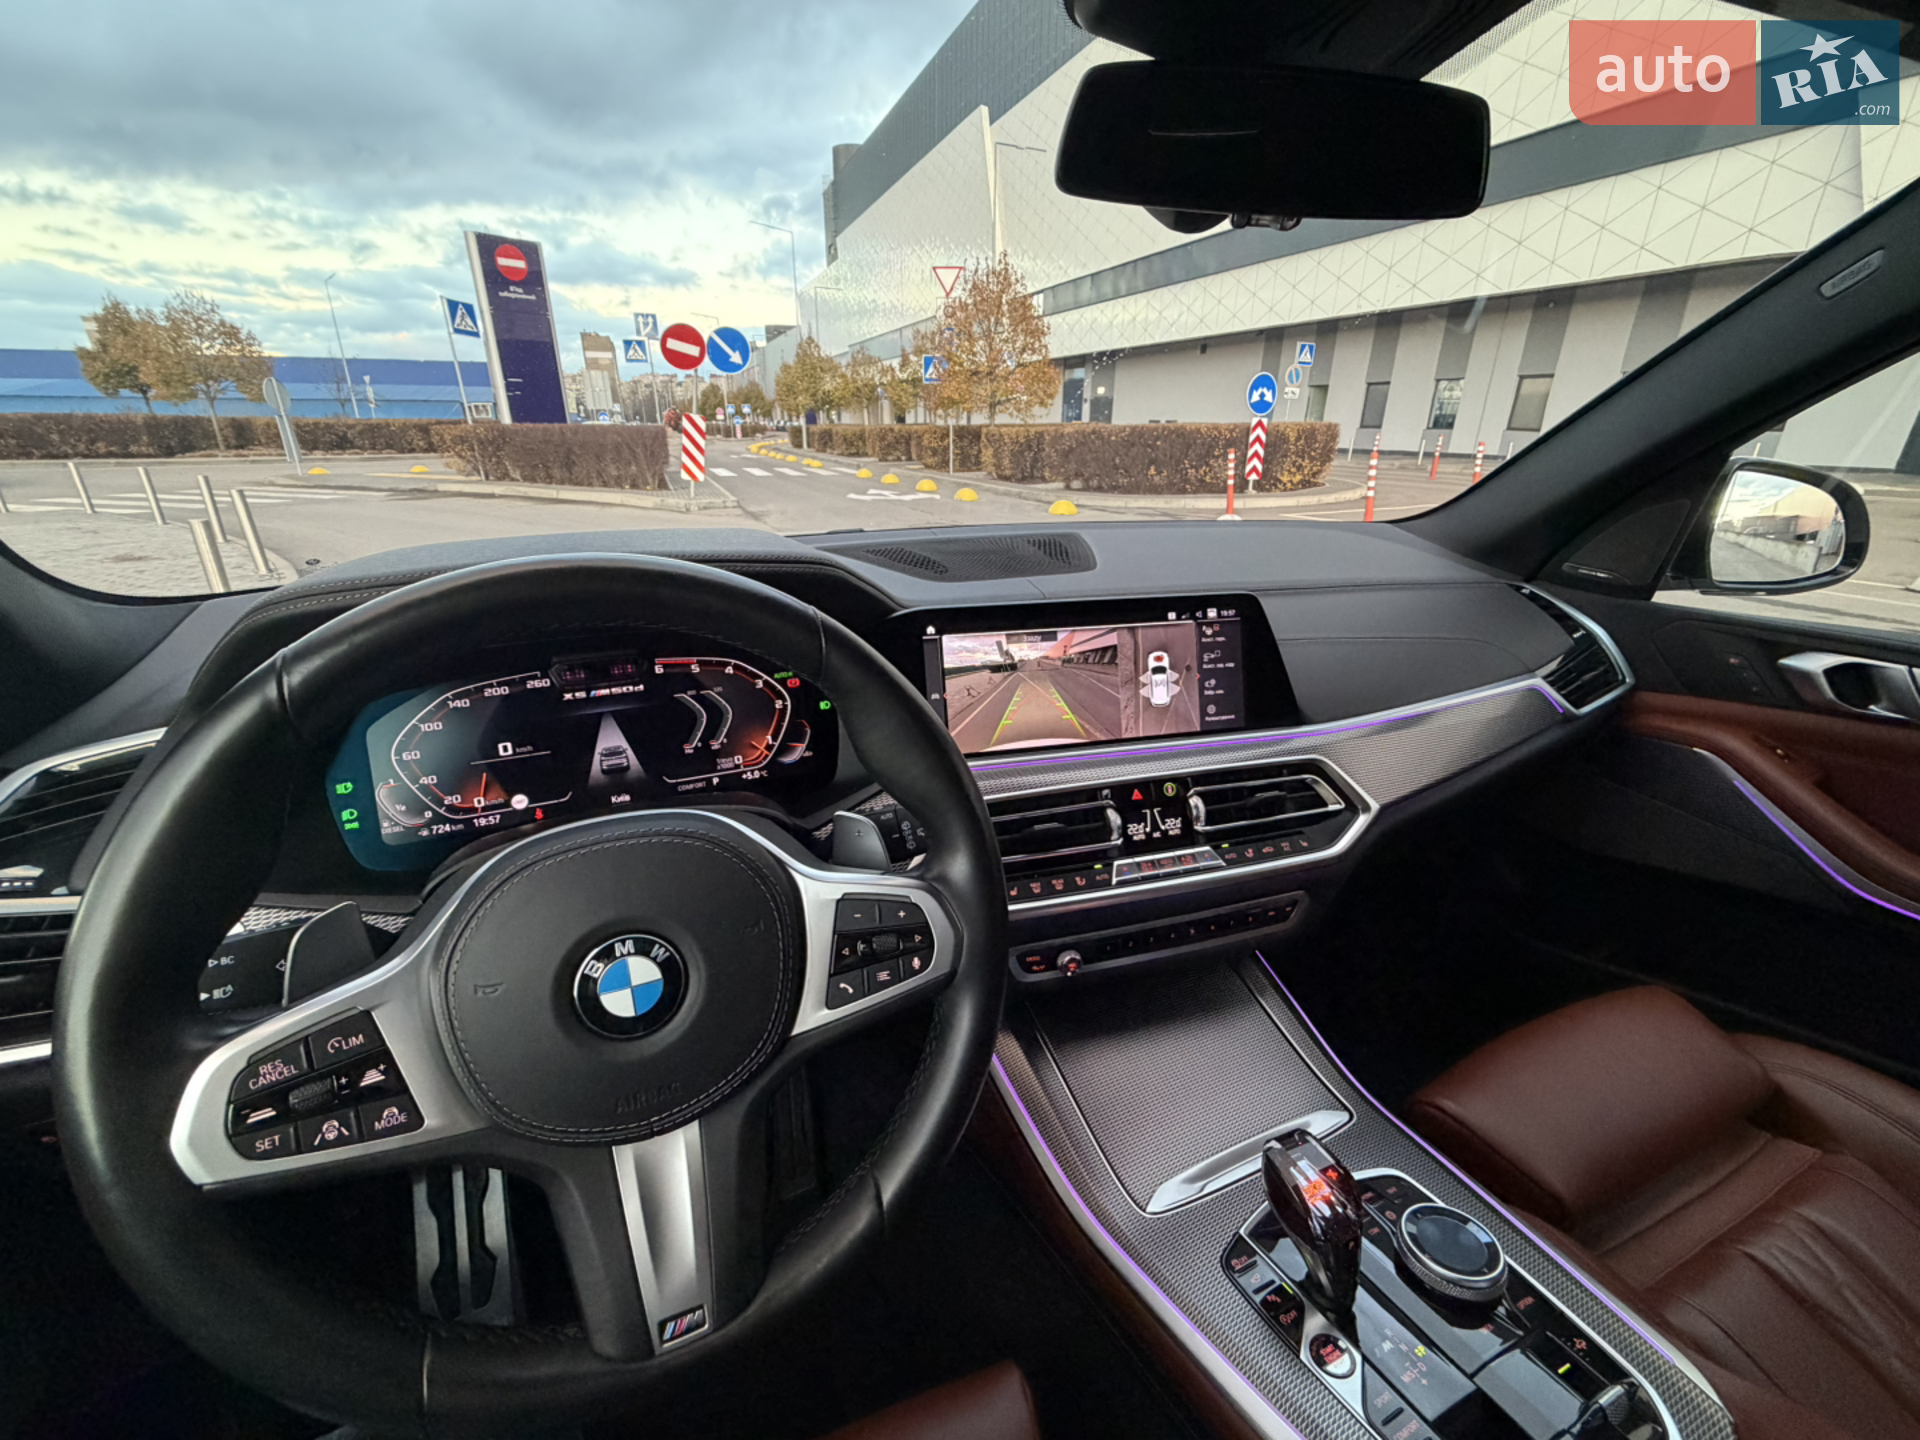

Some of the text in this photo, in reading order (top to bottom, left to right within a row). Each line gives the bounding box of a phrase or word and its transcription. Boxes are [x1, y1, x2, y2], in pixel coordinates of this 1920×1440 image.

[1220, 609, 1236, 617] 19:57
[655, 665, 664, 674] 6
[691, 664, 700, 673] 5
[725, 666, 734, 674] 4
[526, 678, 551, 689] 260
[755, 679, 763, 688] 3
[484, 686, 510, 697] 200
[447, 698, 470, 709] 140
[775, 700, 784, 709] 2
[418, 721, 443, 732] 100
[497, 742, 513, 757] 0
[402, 750, 421, 761] 60
[735, 755, 743, 764] 0
[419, 775, 437, 784] 40
[742, 771, 761, 779] +5.0
[677, 777, 720, 791] COMFORT P
[444, 794, 461, 805] 20
[473, 796, 485, 808] 0
[611, 794, 631, 804] Київ
[424, 810, 433, 818] 0
[473, 816, 501, 828] 19:57
[431, 823, 452, 835] 724
[220, 955, 235, 966] BC
[584, 939, 671, 979] BMW
[343, 1034, 364, 1050] LIM
[259, 1060, 284, 1076] RES
[248, 1067, 299, 1091] CANCEL
[374, 1112, 408, 1131] MODE
[255, 1134, 281, 1153] SET
